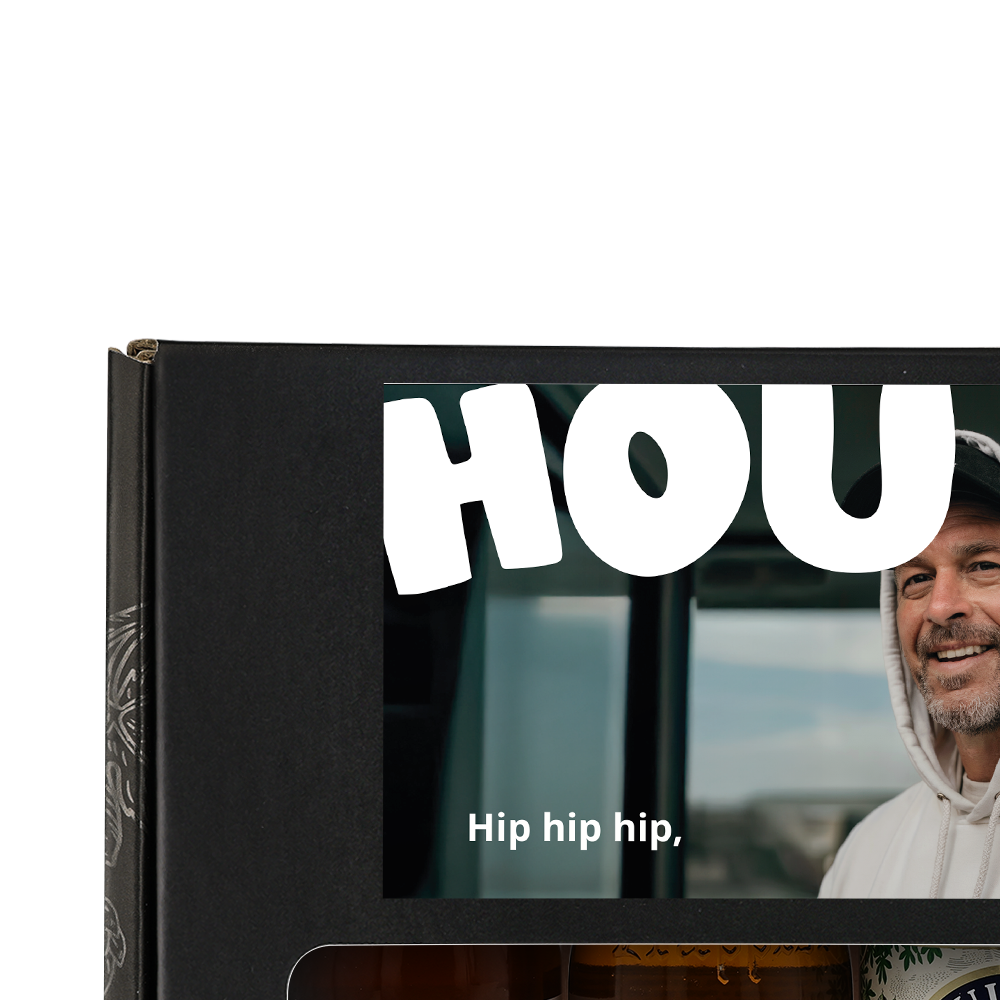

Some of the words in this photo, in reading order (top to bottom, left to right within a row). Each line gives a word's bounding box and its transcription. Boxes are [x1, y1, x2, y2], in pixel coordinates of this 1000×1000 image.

[383, 383, 956, 595] HOU
[469, 811, 531, 851] Hip
[543, 811, 602, 851] hip
[614, 811, 682, 851] hip,
